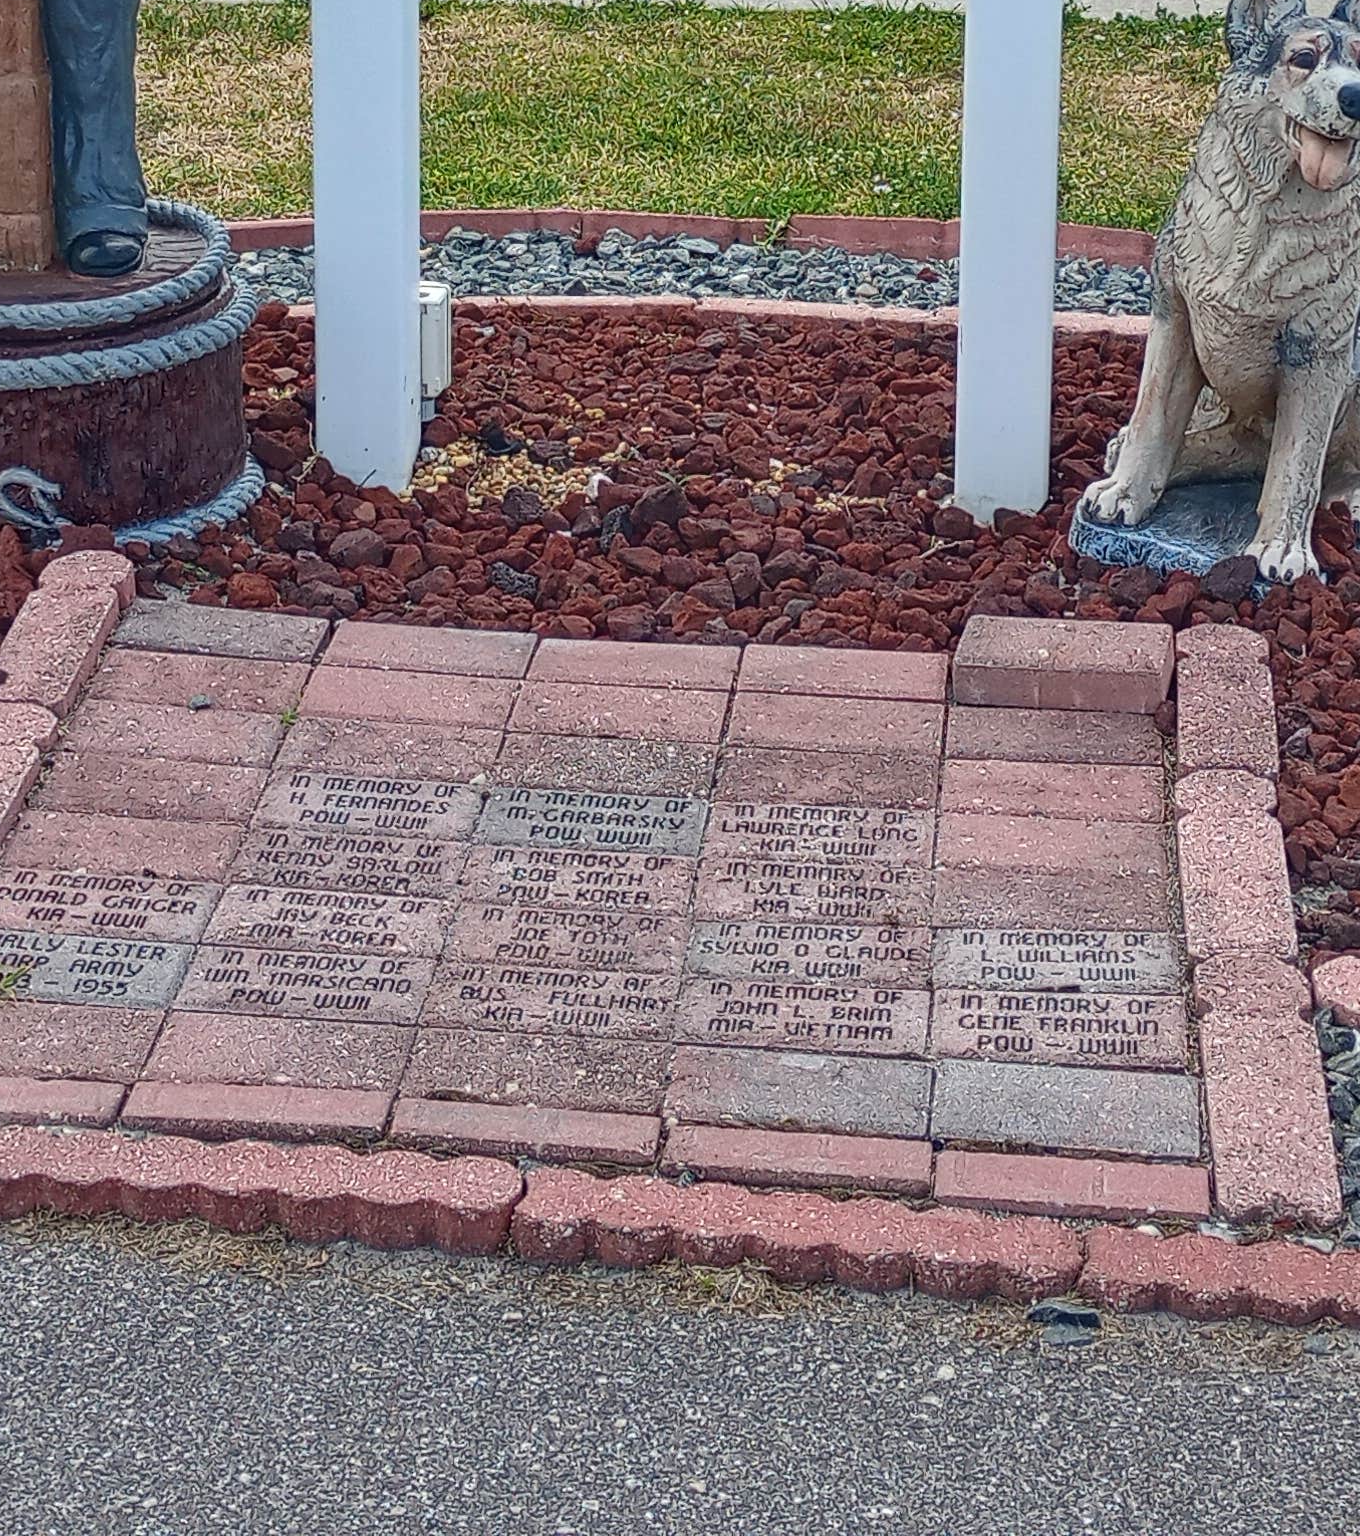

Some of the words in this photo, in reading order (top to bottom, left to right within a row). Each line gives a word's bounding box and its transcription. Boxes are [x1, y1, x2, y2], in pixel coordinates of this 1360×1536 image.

[290, 775, 311, 788] IN
[323, 777, 421, 795] MEMORY
[435, 785, 461, 798] OF
[323, 794, 450, 814] FERNANDES
[509, 790, 531, 802] IN
[545, 792, 650, 810] MEMORY
[665, 800, 692, 813] OF
[299, 810, 351, 825] POW
[543, 811, 685, 830] GARBARSKY
[734, 805, 754, 817] IN
[770, 806, 869, 823] MEMORY
[884, 813, 911, 824] OF
[266, 834, 288, 847] IN
[529, 826, 582, 840] POW
[597, 830, 652, 845] WWII
[722, 820, 844, 837] LAWRENCE
[858, 827, 918, 841] LONG
[759, 838, 795, 852] KIA
[823, 842, 877, 856] WWII
[494, 850, 514, 862] IN
[528, 851, 630, 867] MEMORY
[644, 857, 672, 870] OF
[573, 871, 644, 887] SMITH
[727, 863, 748, 875] IN
[762, 864, 864, 881] MEMORY
[880, 870, 908, 884] OF
[13, 872, 38, 885] IN
[49, 874, 155, 893] MEMORY
[166, 882, 201, 896] OF
[497, 884, 549, 900] POW
[575, 889, 650, 904] KOREA
[247, 889, 268, 901] IN
[282, 892, 387, 910] MEMORY
[399, 901, 430, 914] OF
[26, 907, 66, 921] KIA
[91, 912, 147, 929] WWII
[270, 908, 318, 921] JAY
[329, 913, 392, 929] BECK
[482, 909, 503, 921] IN
[518, 910, 623, 928] MEMORY
[638, 917, 665, 932] OF
[249, 923, 295, 938] MIA
[320, 928, 397, 946] KOREA
[510, 928, 550, 941] JOE
[569, 931, 629, 946] TOTH
[720, 924, 740, 937] IN
[756, 925, 863, 942] MEMORY
[878, 930, 906, 944] OF
[963, 932, 984, 945] IN
[1000, 932, 1107, 947] MEMORY
[1124, 934, 1150, 946] OF
[77, 941, 167, 961] LESTER
[1018, 950, 1135, 963] WILLIAMS
[69, 959, 143, 978] ARMY
[221, 951, 244, 964] IN
[259, 953, 368, 972] MEMORY
[380, 960, 409, 975] OF
[751, 960, 790, 974] KIA
[269, 973, 412, 994] MARSICANO
[500, 969, 609, 989] MEMORY
[981, 966, 1035, 980] POW
[1079, 967, 1136, 981] WWII
[74, 978, 128, 996] 1955
[710, 983, 732, 995] IN
[748, 984, 859, 1001] MEMORY
[874, 990, 903, 1004] OF
[230, 989, 286, 1005] POW
[313, 994, 371, 1010] WWII
[548, 990, 673, 1012] FULLHART
[716, 1001, 778, 1015] JOHN
[960, 995, 982, 1009] IN
[998, 996, 1110, 1013] MEMORY
[1128, 999, 1156, 1014] OF
[483, 1005, 524, 1021] KIA
[708, 1018, 754, 1032] MIA
[785, 1022, 893, 1039] VIETNAM
[958, 1015, 1023, 1030] GENE
[1040, 1017, 1159, 1035] FRANKLIN
[977, 1035, 1033, 1052] POW
[1080, 1038, 1138, 1055] WWII
